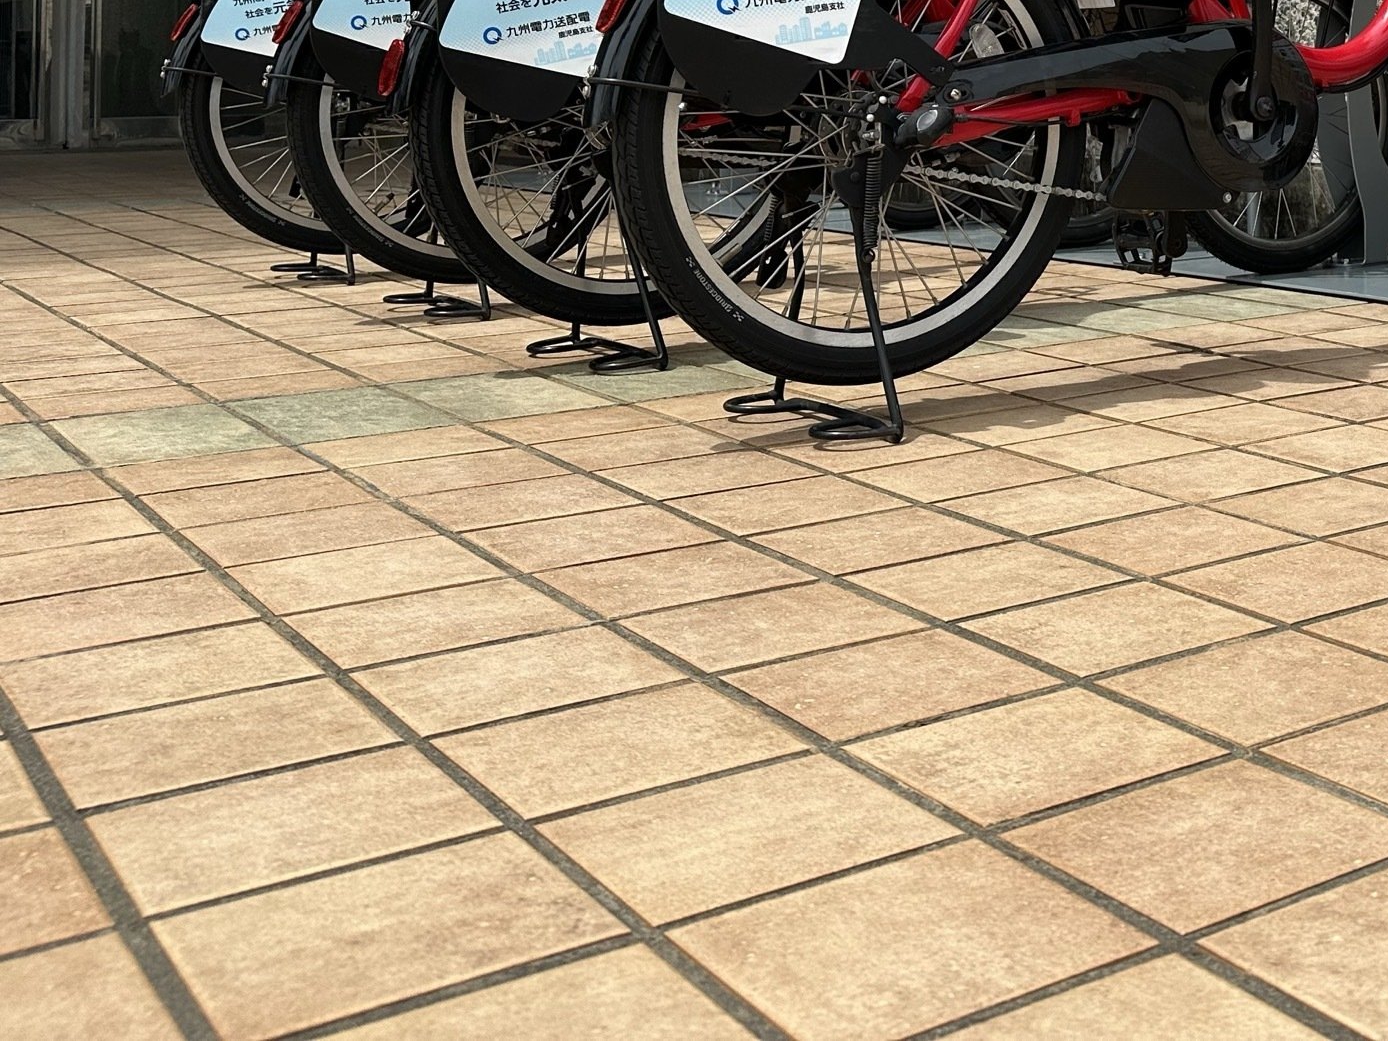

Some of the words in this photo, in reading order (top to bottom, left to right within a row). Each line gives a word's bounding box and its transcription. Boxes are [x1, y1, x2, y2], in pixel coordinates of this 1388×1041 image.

[245, 0, 293, 18] 社会を元
[805, 1, 845, 14] 鹿児島支社
[506, 11, 591, 38] 九州電力送配電
[558, 26, 594, 39] 鹿児島支社
